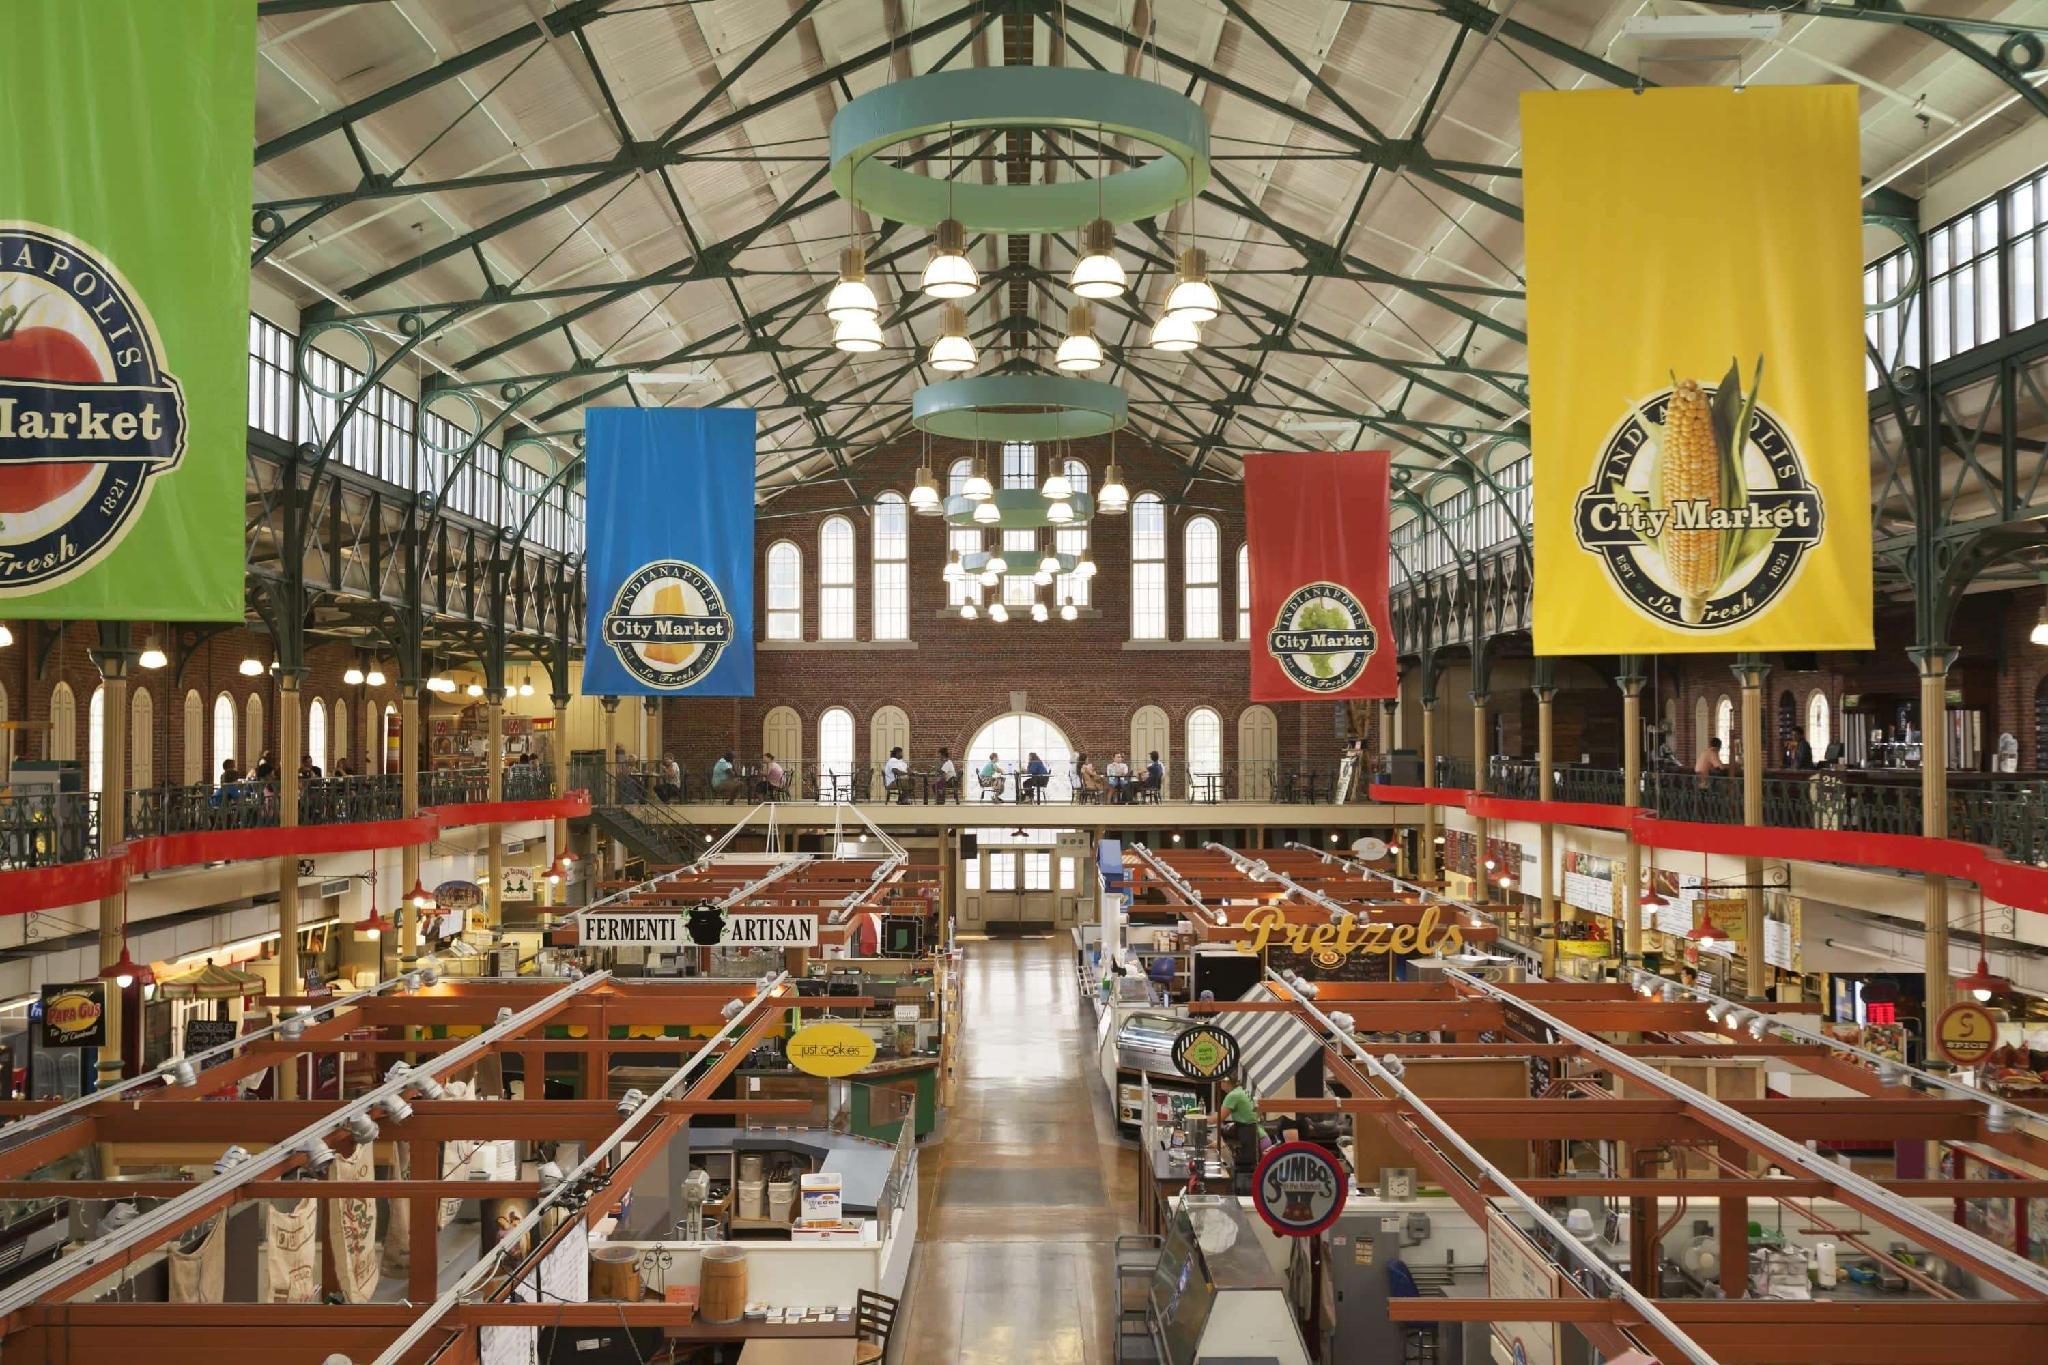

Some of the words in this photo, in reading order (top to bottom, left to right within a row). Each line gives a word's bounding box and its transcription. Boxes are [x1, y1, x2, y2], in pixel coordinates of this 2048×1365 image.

[0, 242, 143, 368] APOLIS
[99, 477, 129, 517] 1821
[1590, 502, 1668, 537] City
[1673, 498, 1811, 530] Market
[1616, 553, 1636, 579] EST
[1769, 552, 1790, 578] 1821
[621, 567, 718, 611] INDIANAPOLIS
[1281, 588, 1364, 626] INDIANAPOLIS
[1648, 595, 1677, 614] So
[612, 620, 652, 639] City
[655, 620, 724, 636] Market
[1274, 634, 1309, 651] City
[1311, 633, 1370, 648] Market
[659, 668, 695, 684] Fresh
[1317, 674, 1347, 687] Fresh
[585, 917, 677, 941] FERMENTI
[731, 917, 812, 941] ARTISAN
[1235, 905, 1464, 955] Pretzels
[47, 1007, 77, 1026] PAPA
[79, 1002, 102, 1019] GUS
[801, 1043, 817, 1058] just
